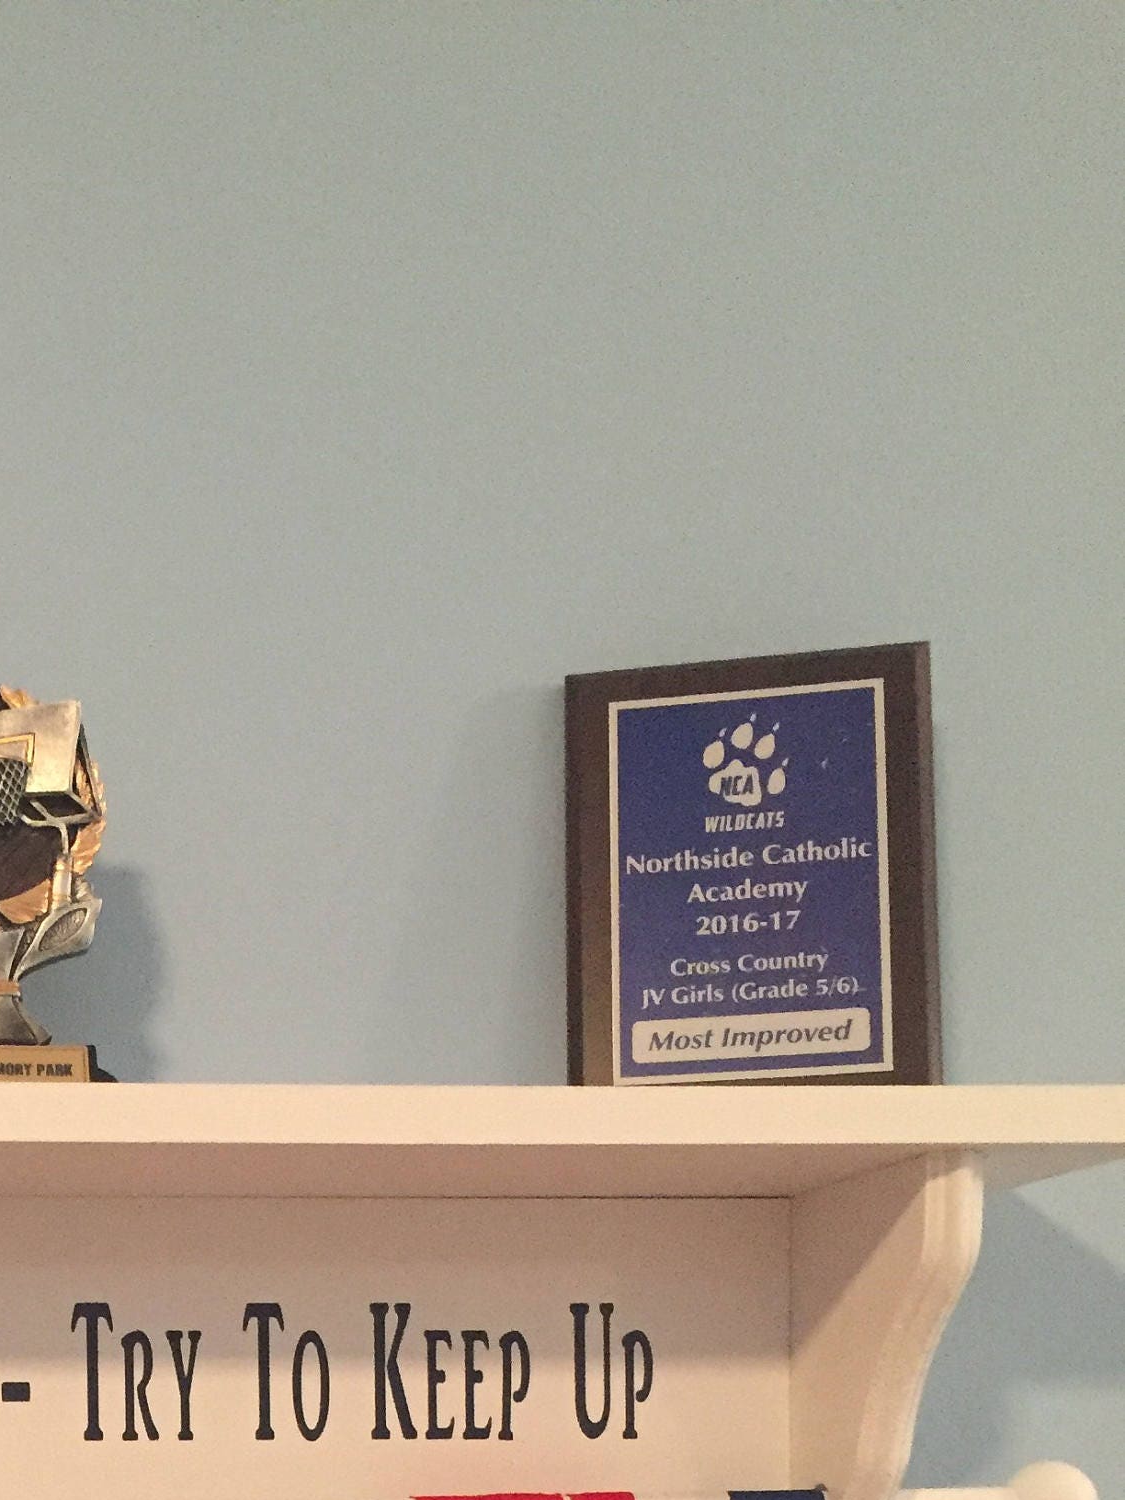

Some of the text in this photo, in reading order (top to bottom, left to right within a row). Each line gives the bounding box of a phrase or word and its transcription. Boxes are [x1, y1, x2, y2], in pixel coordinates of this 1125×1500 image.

[705, 811, 785, 833] WILDCATS
[626, 837, 872, 876] Northside Catholic
[687, 877, 808, 905] Academy
[696, 910, 801, 936] 2016-17
[670, 950, 829, 977] Cross Country
[641, 976, 860, 1010] JV Girls (Grade 5/6)
[648, 1019, 853, 1052] Most Improved
[36, 1062, 74, 1077] PARK
[71, 1302, 202, 1441] TRY
[242, 1302, 330, 1442] TO
[369, 1302, 531, 1441] KEEP
[569, 1302, 654, 1440] UP
